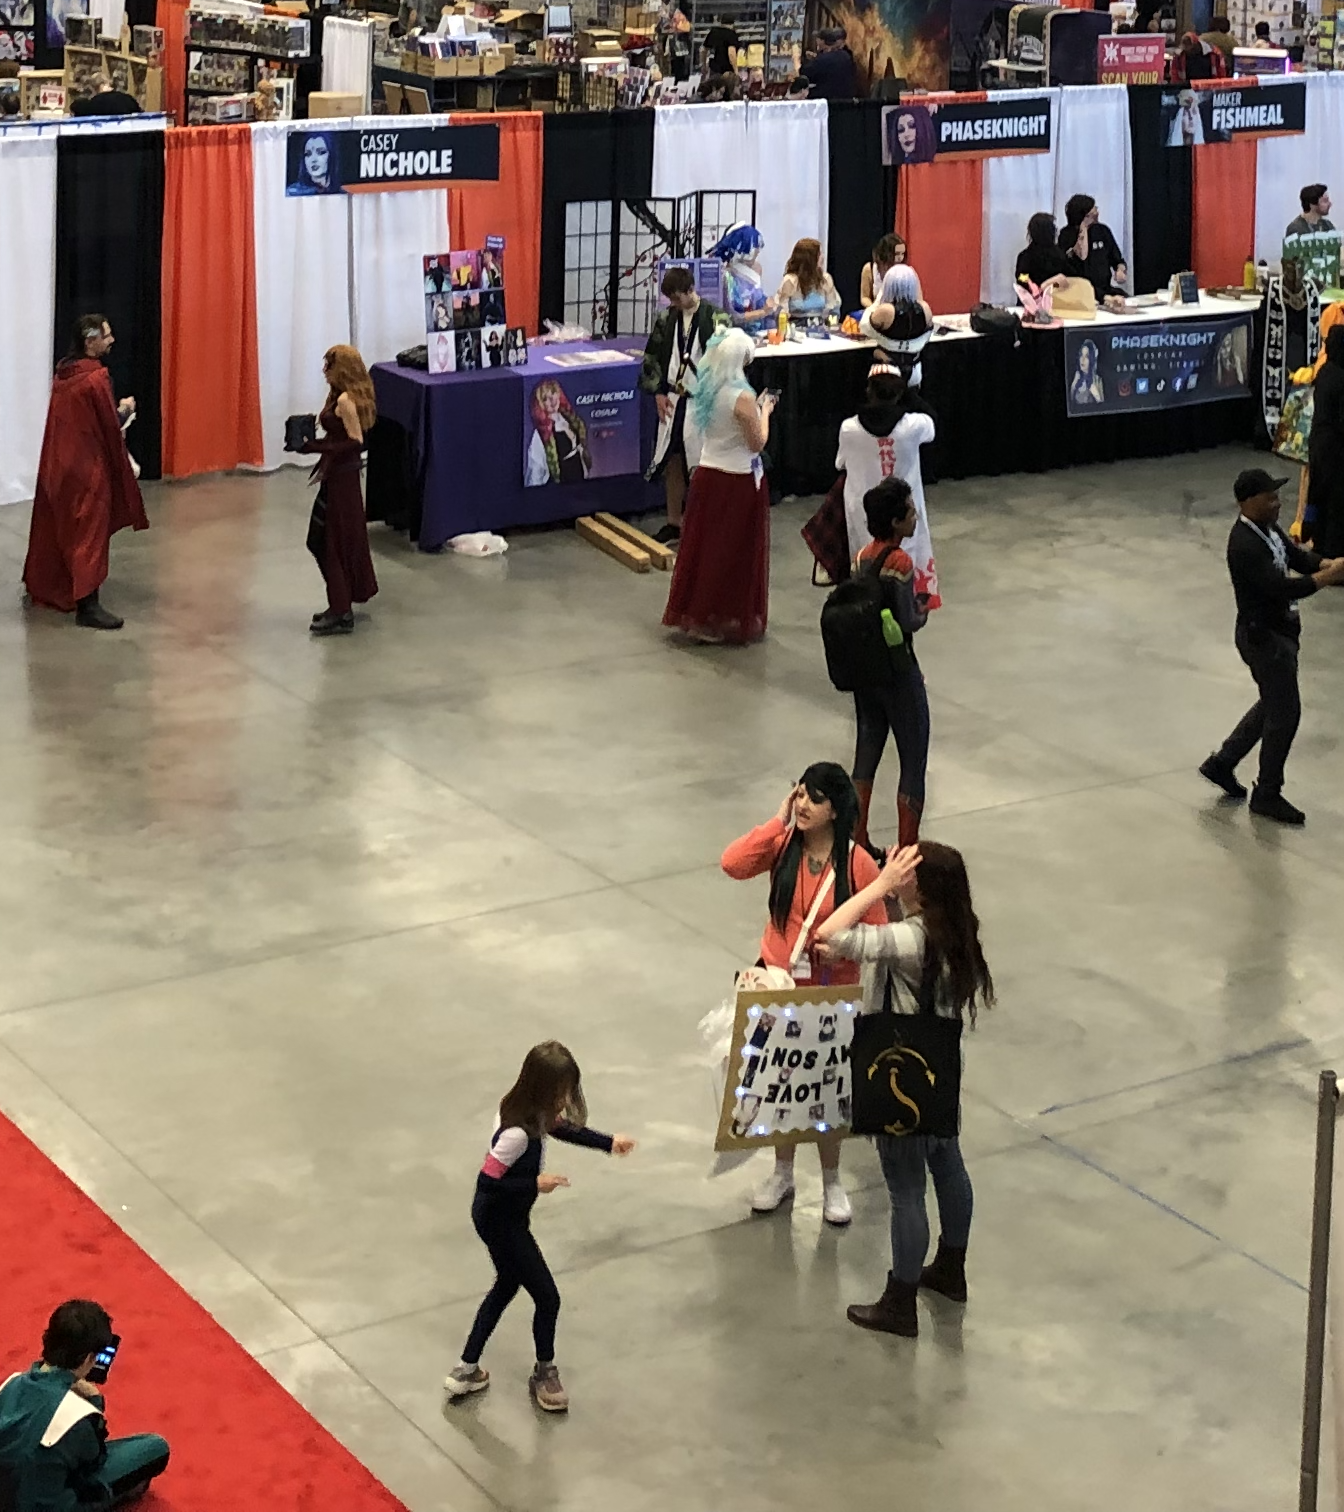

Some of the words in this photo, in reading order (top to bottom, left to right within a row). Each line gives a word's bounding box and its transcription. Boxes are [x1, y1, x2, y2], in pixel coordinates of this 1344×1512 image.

[1101, 72, 1128, 84] SCAN
[1132, 71, 1158, 84] YOUR
[1212, 92, 1242, 108] MAKER
[1212, 104, 1284, 130] FISHMEAL
[940, 115, 1047, 142] PHASEKNIGHT
[360, 134, 399, 152] CASEY
[360, 148, 453, 179] NICHOLE
[1112, 332, 1216, 349] PHASEKNIGHT
[576, 393, 601, 405] CASEY
[759, 1046, 819, 1074] SON!
[763, 1081, 822, 1104] LOVE
[835, 1076, 844, 1095] I
